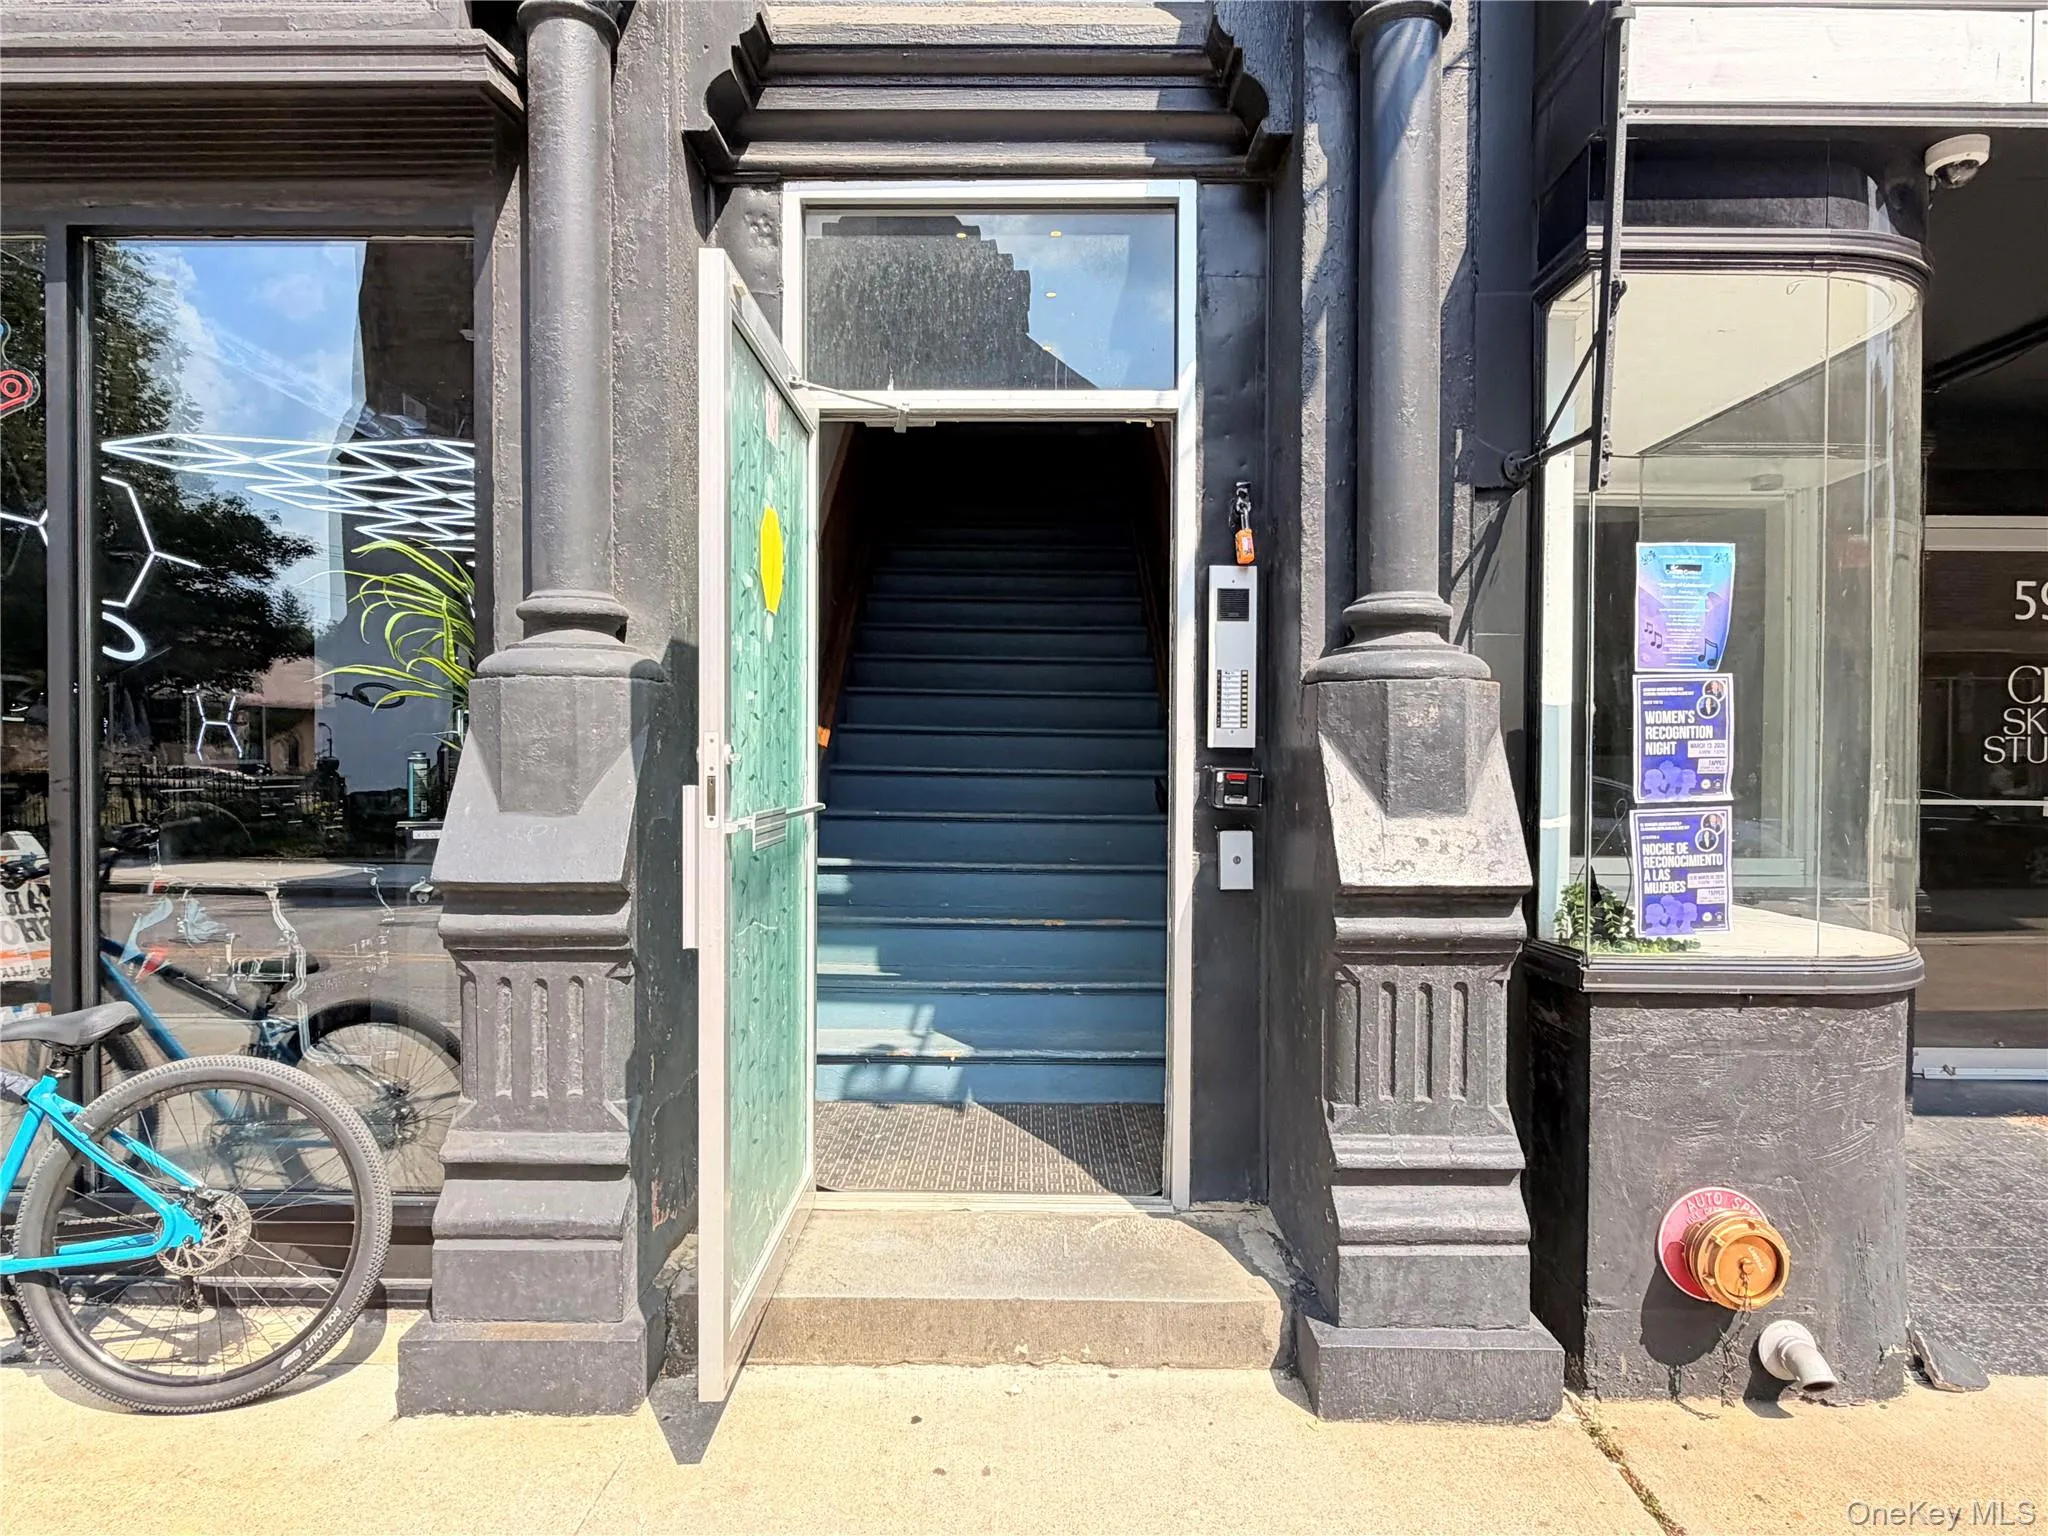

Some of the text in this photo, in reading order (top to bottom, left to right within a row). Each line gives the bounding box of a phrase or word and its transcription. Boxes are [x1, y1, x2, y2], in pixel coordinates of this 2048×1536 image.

[2007, 665, 2048, 704] C
[1644, 709, 1696, 725] WOMEN'S
[1645, 725, 1714, 740] RECOGNITION
[1645, 741, 1678, 756] NIGHT
[1983, 735, 2048, 764] STU
[1642, 841, 1689, 856] NOCHE DE
[1643, 853, 1724, 868] RECONOCIMIENTO
[1643, 868, 1671, 882] A LAS
[1644, 881, 1687, 895] MUJERES
[1686, 1191, 1723, 1214] AUTO
[305, 1306, 342, 1352] ROLLOUT
